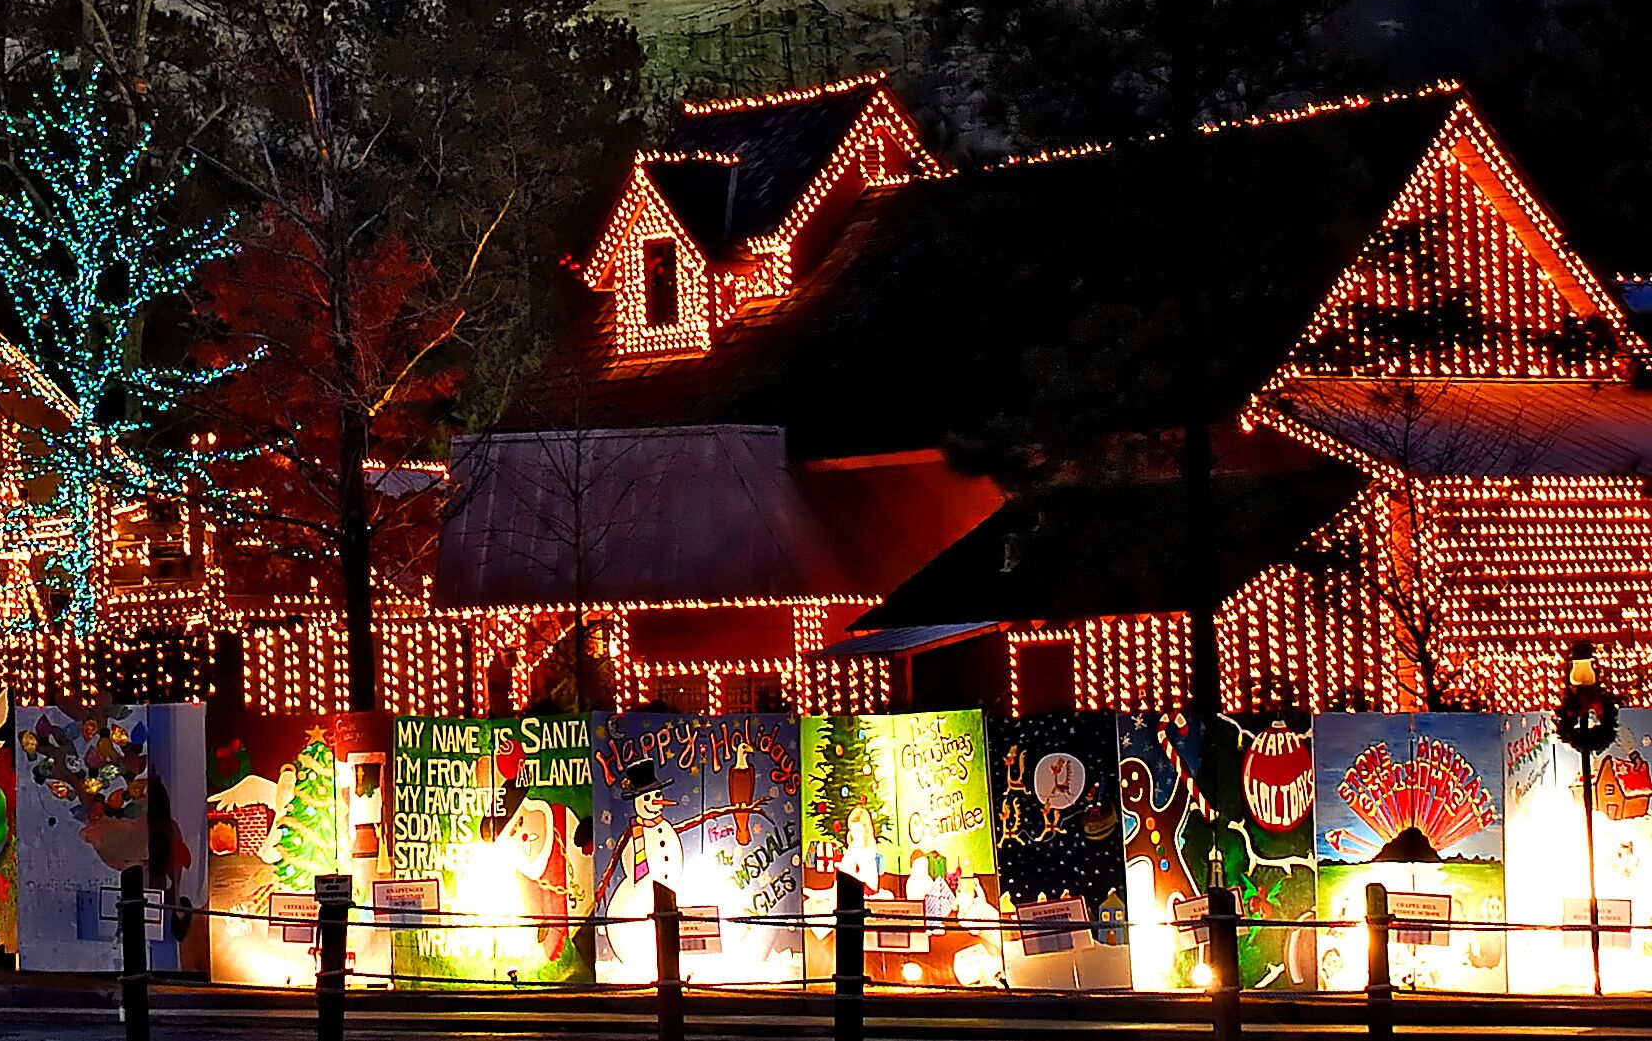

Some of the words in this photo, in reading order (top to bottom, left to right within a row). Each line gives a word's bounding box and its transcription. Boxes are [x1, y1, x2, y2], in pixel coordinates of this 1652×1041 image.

[397, 720, 425, 748] MY
[432, 724, 480, 754] NAME
[494, 727, 514, 756] IS
[520, 717, 590, 754] SANTA
[901, 732, 974, 772] Christmas
[1251, 731, 1302, 756] HAPPY
[396, 753, 421, 784] I'M
[427, 758, 478, 788] FROM
[515, 757, 593, 789] ATLANTA
[595, 723, 698, 786] Happy
[710, 718, 802, 796] Holidays
[1337, 741, 1392, 807] STONE
[395, 785, 421, 813] MY
[425, 786, 507, 818] FAVORITE
[1244, 768, 1315, 827] HOLIDAYS
[394, 812, 442, 842] SODA
[449, 815, 473, 843] IS
